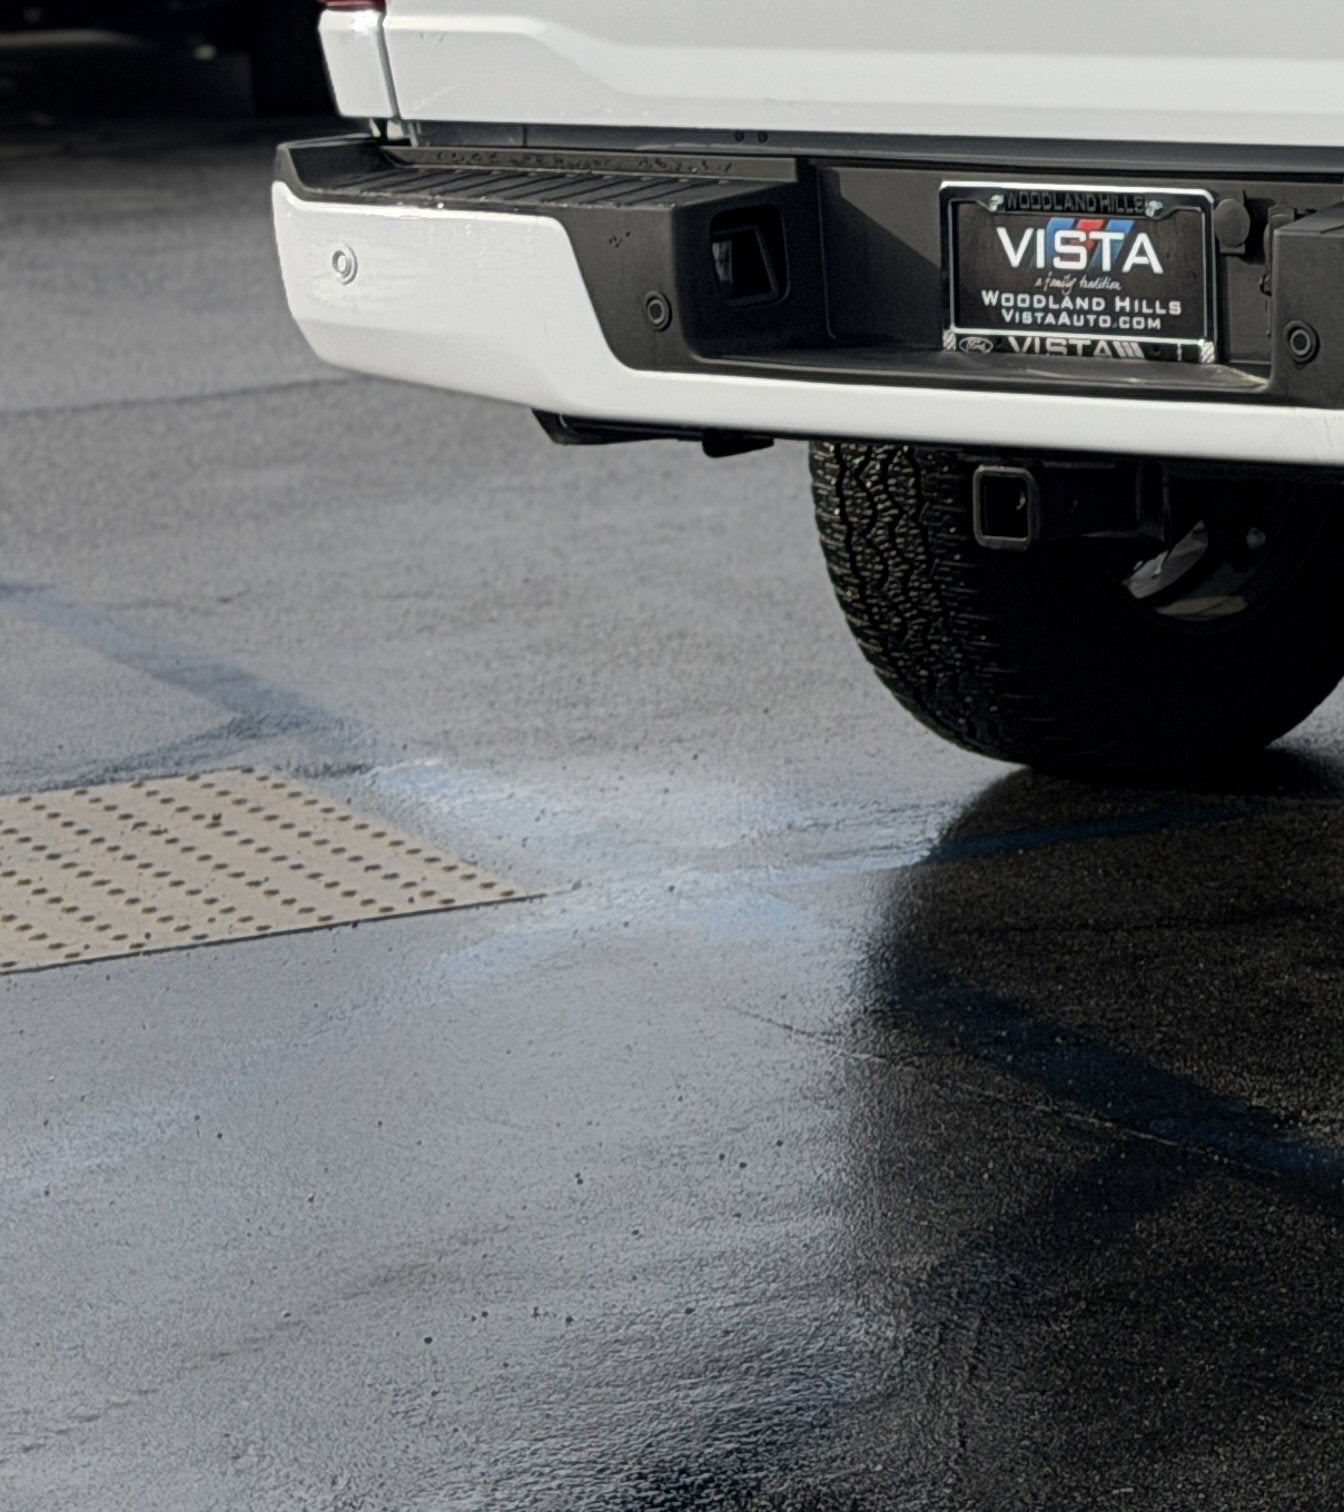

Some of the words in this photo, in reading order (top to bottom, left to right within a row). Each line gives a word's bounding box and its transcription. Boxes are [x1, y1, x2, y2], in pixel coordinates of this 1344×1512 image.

[1006, 191, 1098, 212] WOODLAND
[996, 226, 1164, 274] VISTA
[1007, 335, 1113, 358] VISTA
